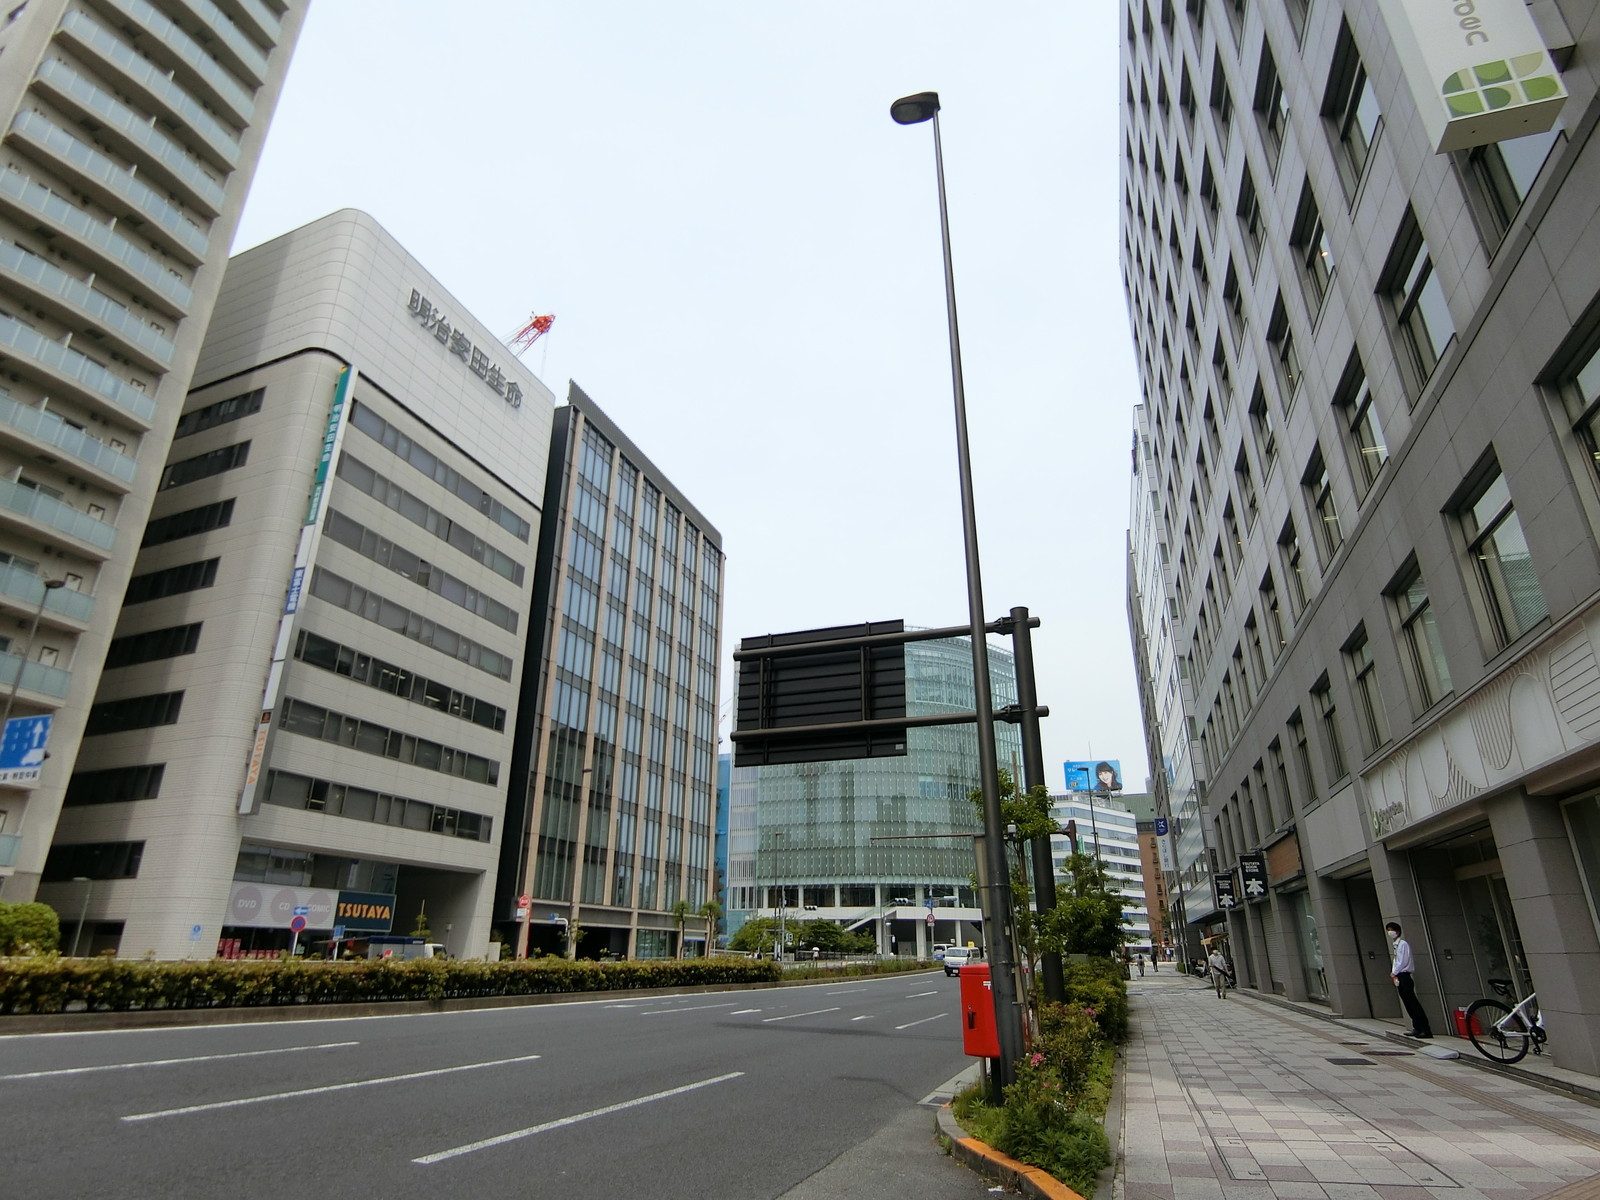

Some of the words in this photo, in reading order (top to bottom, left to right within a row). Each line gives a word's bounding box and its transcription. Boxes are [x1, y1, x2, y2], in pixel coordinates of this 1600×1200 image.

[408, 288, 523, 408] 明治安田生命
[247, 729, 268, 785] TSUTAYA
[1245, 878, 1265, 896] 本
[237, 899, 257, 909] DVD
[279, 901, 290, 911] CD
[1219, 893, 1234, 908] 本
[338, 902, 391, 920] TSUTAYA
